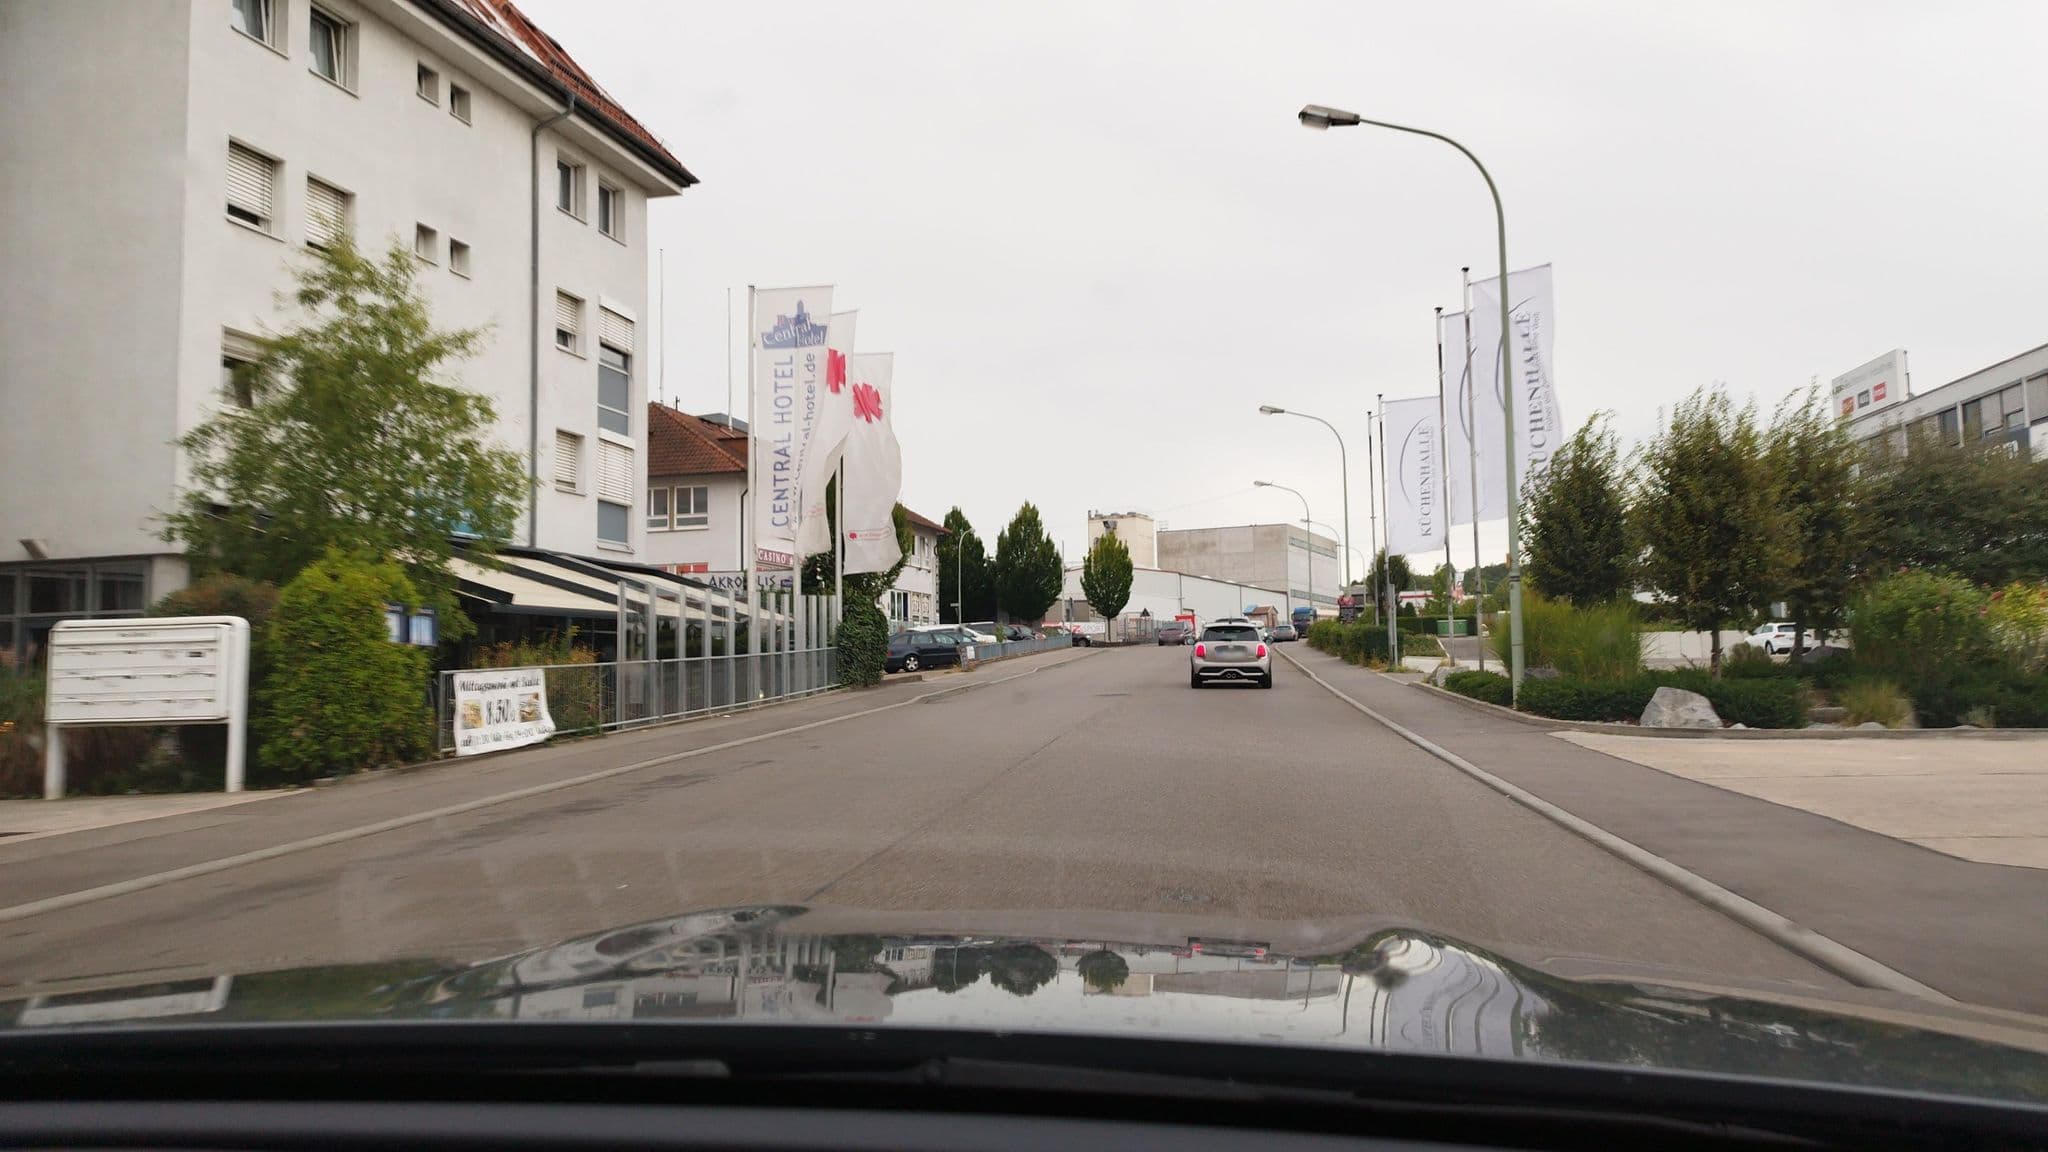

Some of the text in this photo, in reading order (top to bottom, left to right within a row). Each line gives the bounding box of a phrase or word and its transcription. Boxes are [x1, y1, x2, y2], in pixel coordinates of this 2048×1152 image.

[763, 317, 812, 345] Central
[771, 355, 794, 527] CENTRAL HOTEL
[1418, 425, 1433, 537] KÜCHENHALLE
[758, 549, 786, 564] CASINO
[709, 574, 776, 590] AKROLIS
